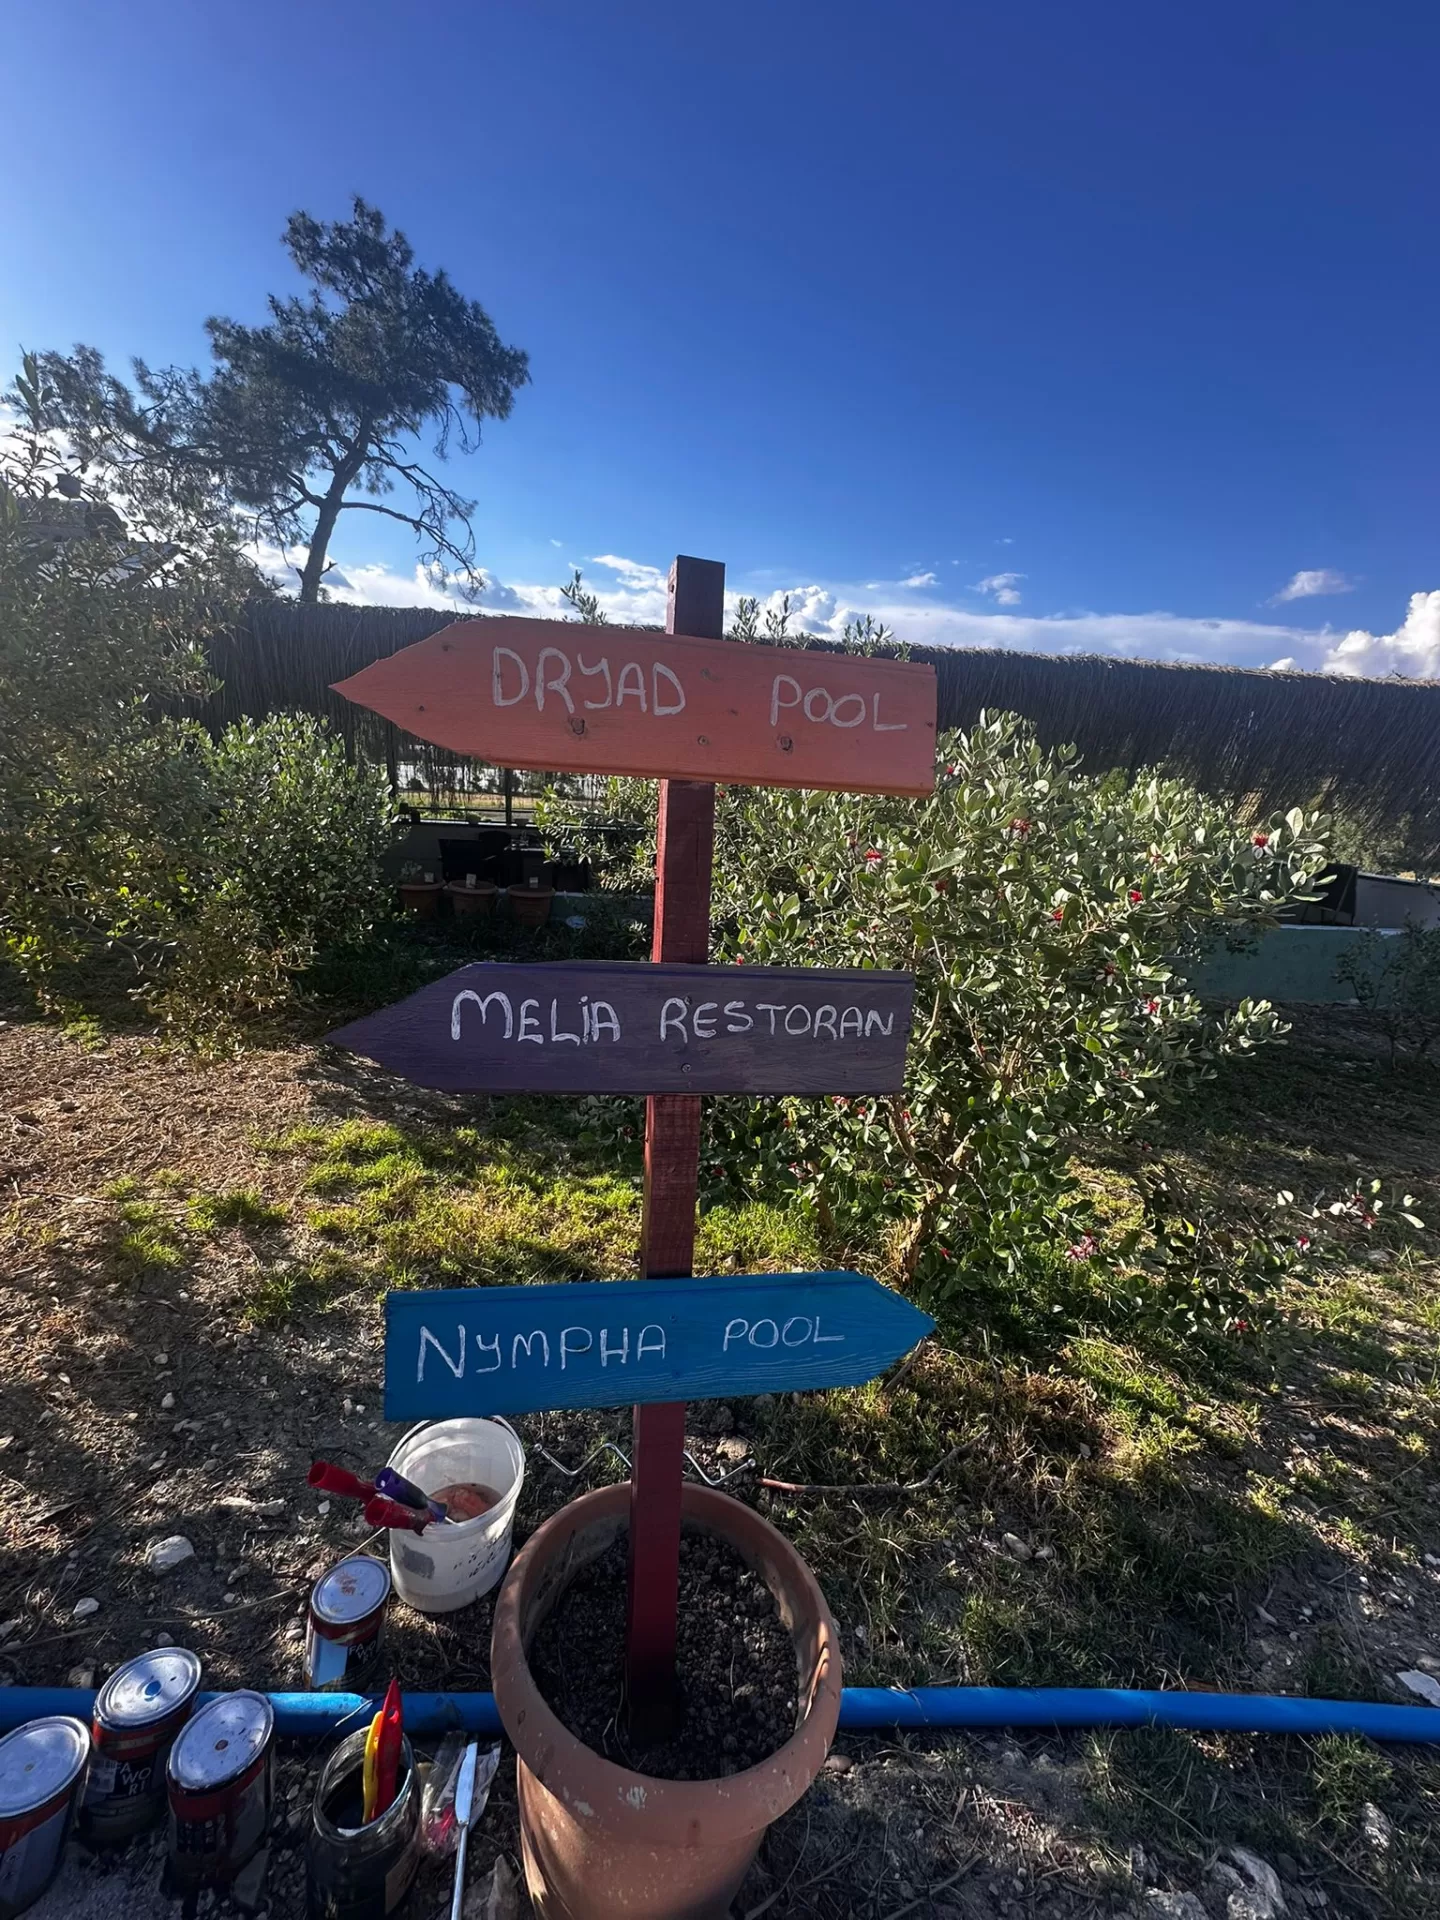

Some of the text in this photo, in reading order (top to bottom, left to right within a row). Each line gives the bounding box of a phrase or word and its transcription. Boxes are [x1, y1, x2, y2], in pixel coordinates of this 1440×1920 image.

[492, 646, 908, 732] DRYAD POOL
[659, 996, 896, 1044] RESTORAN
[722, 1316, 845, 1352] POOL
